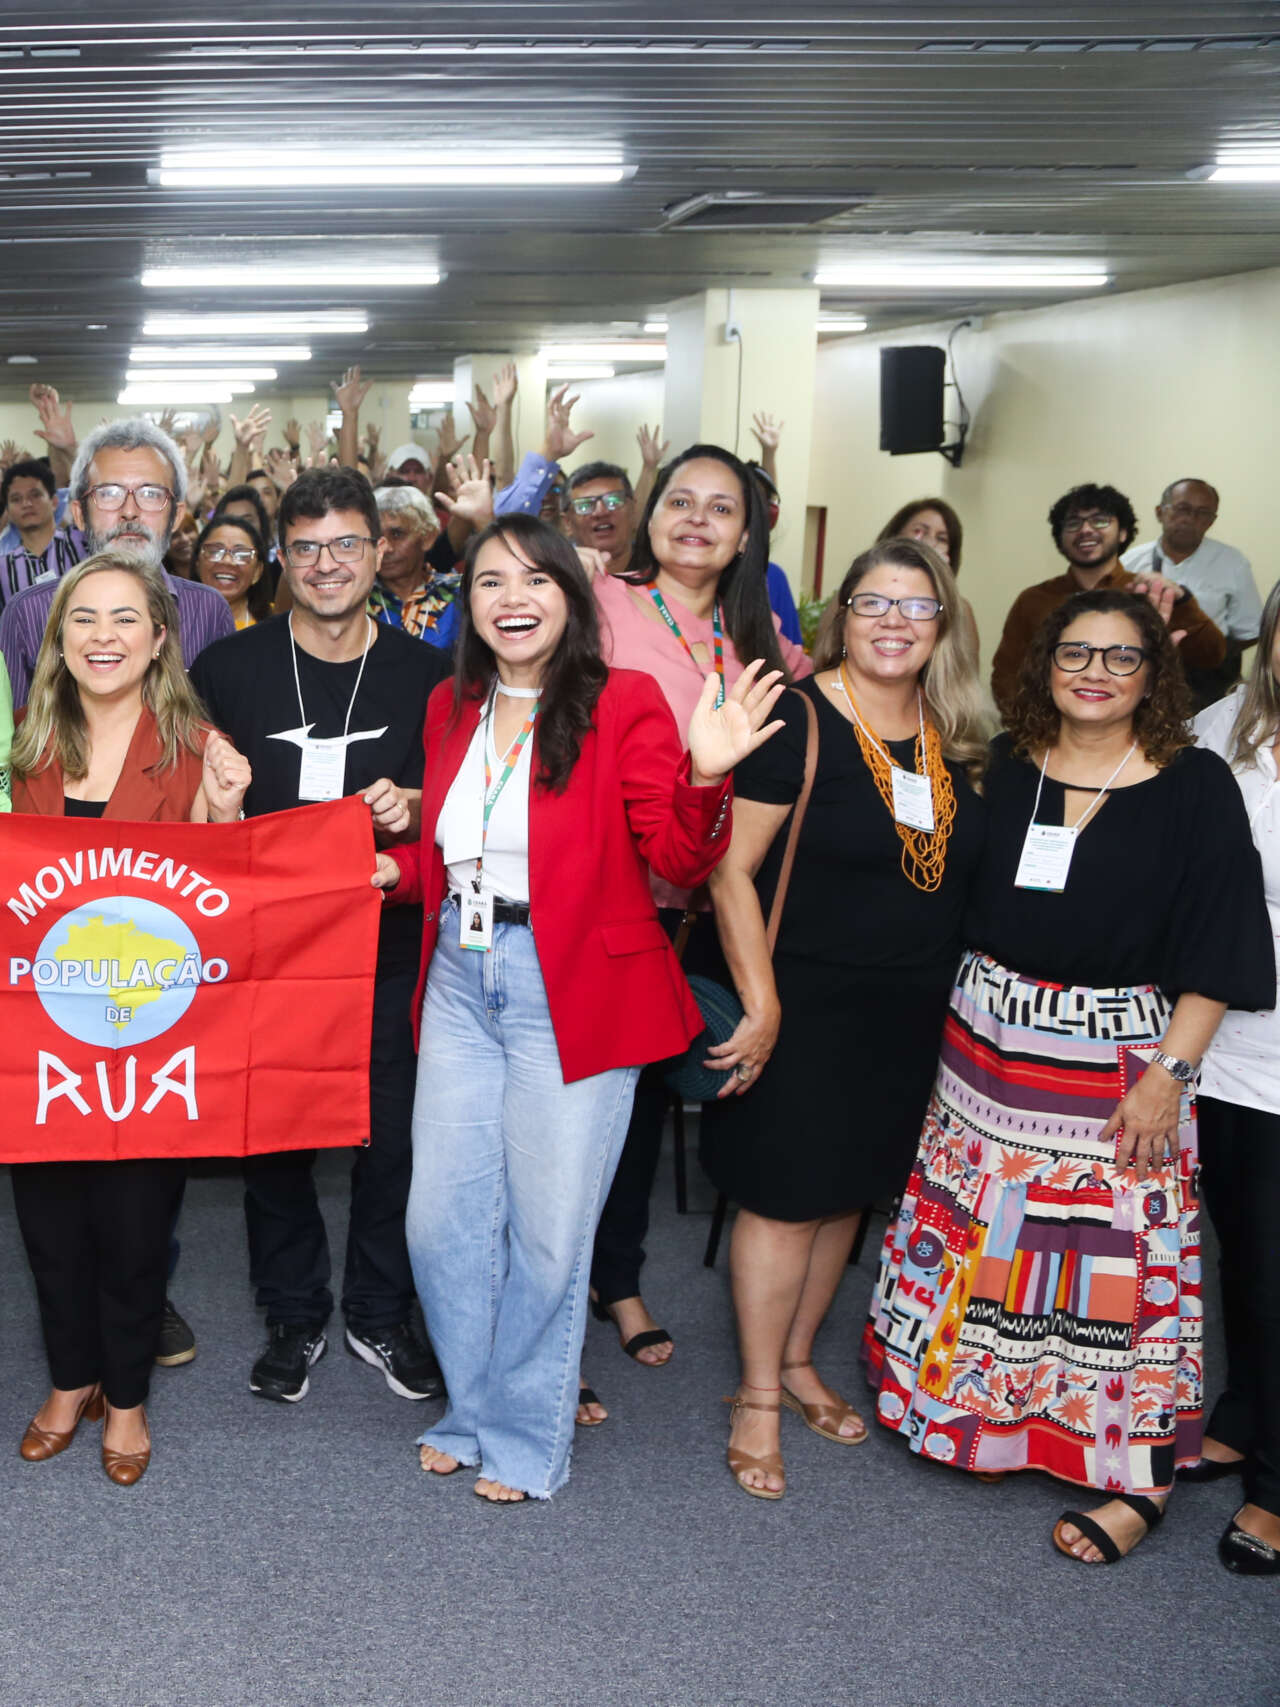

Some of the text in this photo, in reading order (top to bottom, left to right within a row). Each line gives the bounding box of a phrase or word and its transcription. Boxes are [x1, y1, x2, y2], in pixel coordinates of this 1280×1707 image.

[7, 847, 230, 925] MOVIMENTO
[8, 953, 230, 991] POPULAÇÃO
[105, 1005, 132, 1023] DE
